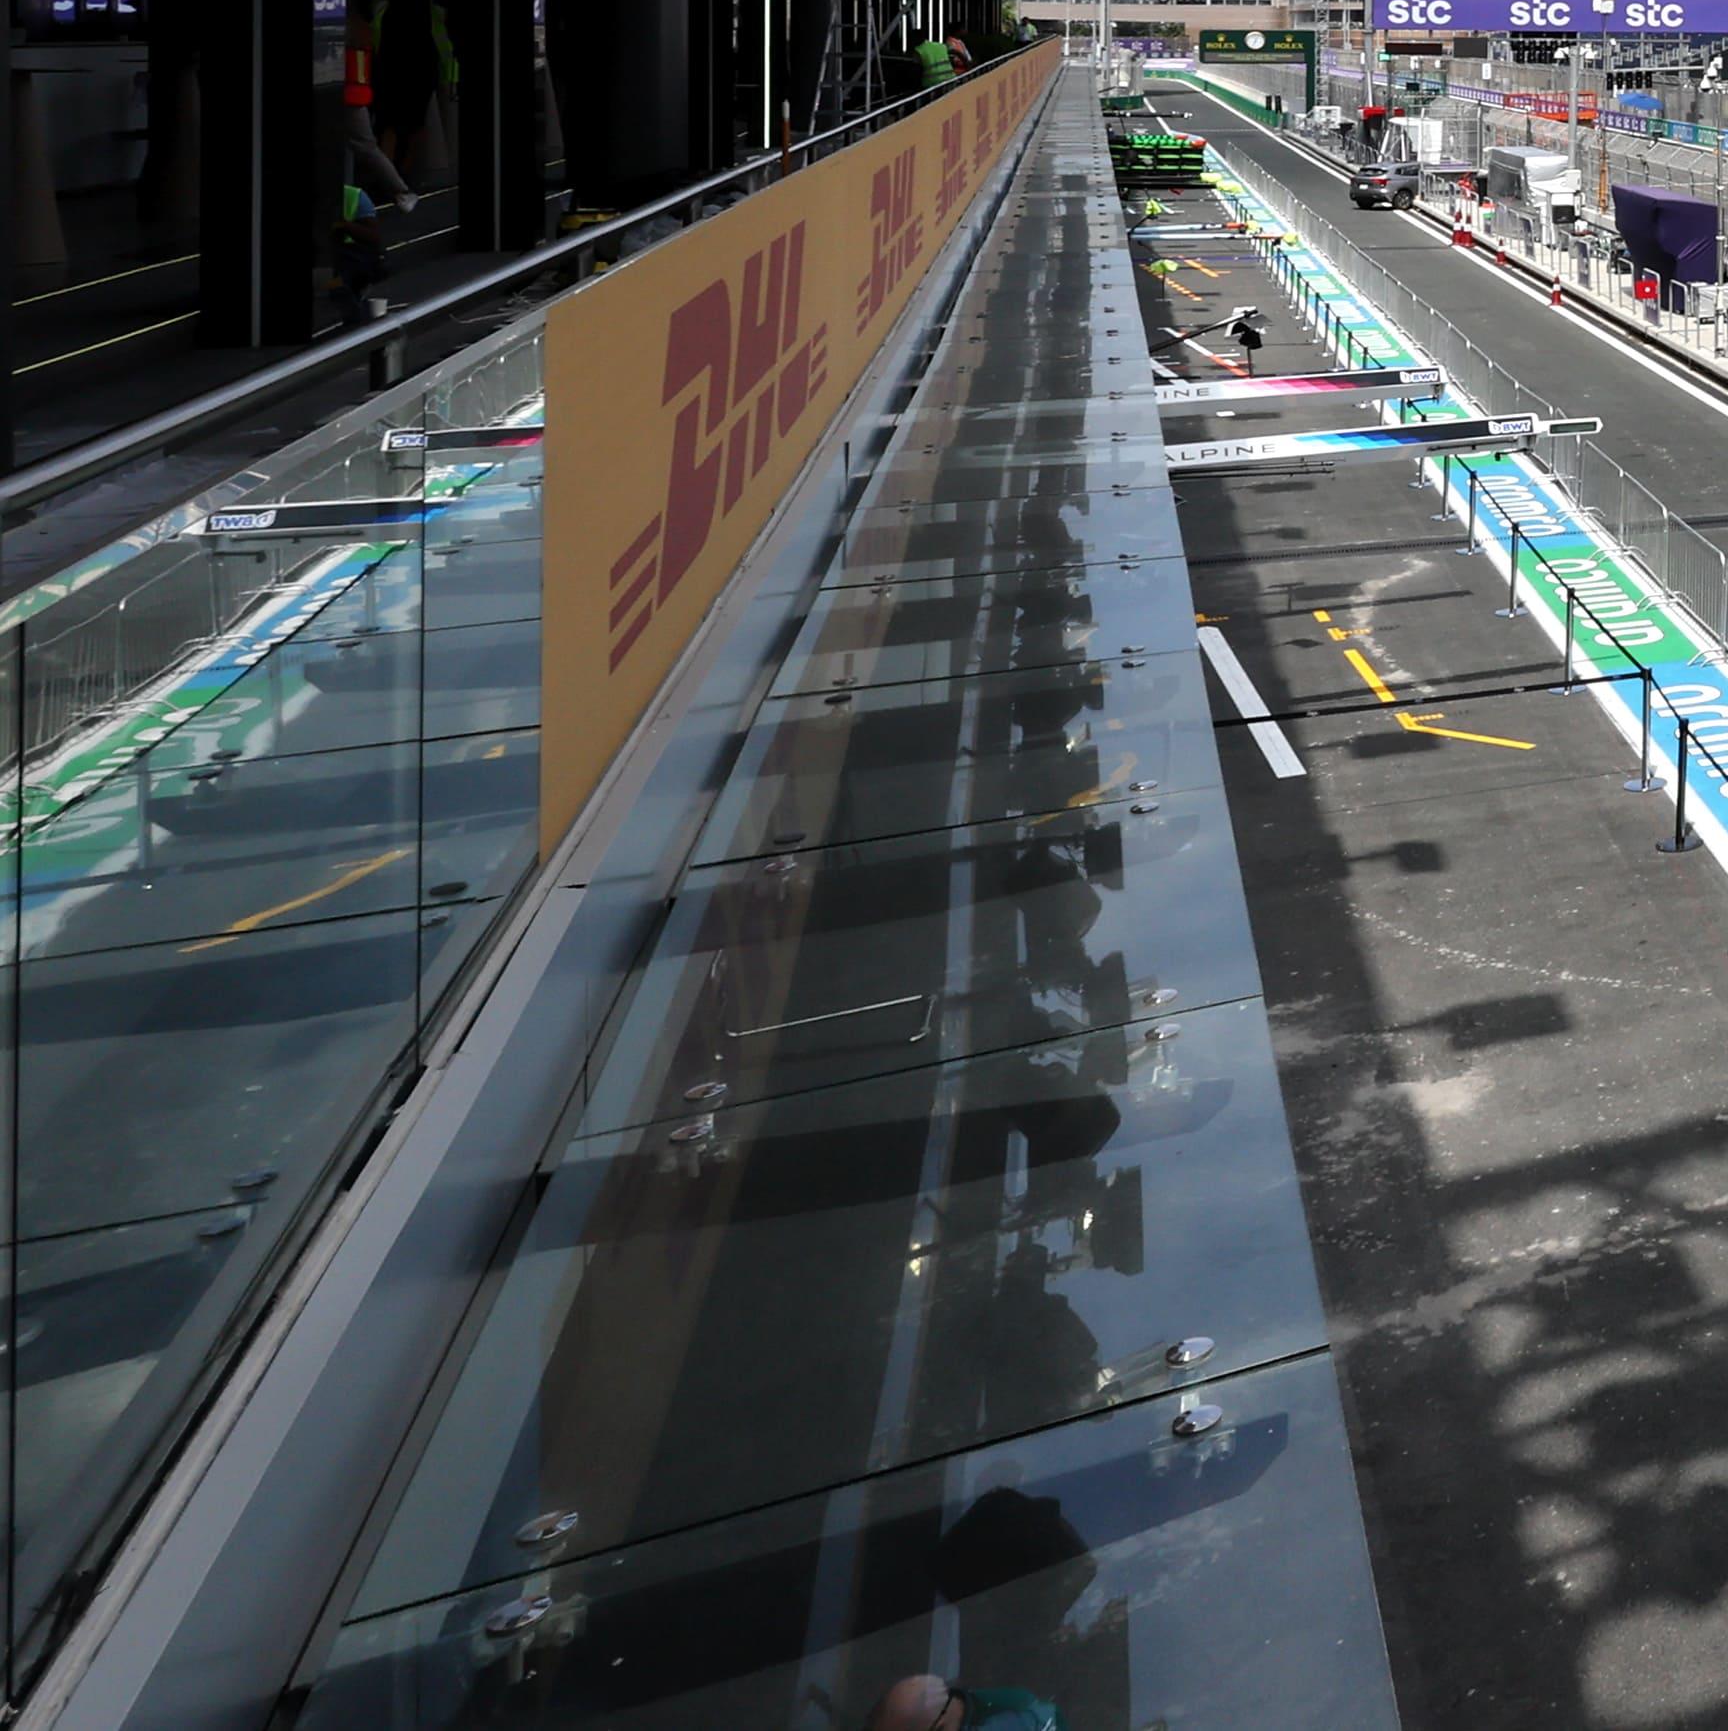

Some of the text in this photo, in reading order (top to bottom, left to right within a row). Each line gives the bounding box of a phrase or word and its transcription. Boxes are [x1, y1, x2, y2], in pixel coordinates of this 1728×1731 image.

[868, 145, 916, 322] DHL
[653, 219, 813, 618] DHL
[1412, 371, 1438, 382] BWT
[1503, 421, 1530, 432] BWT
